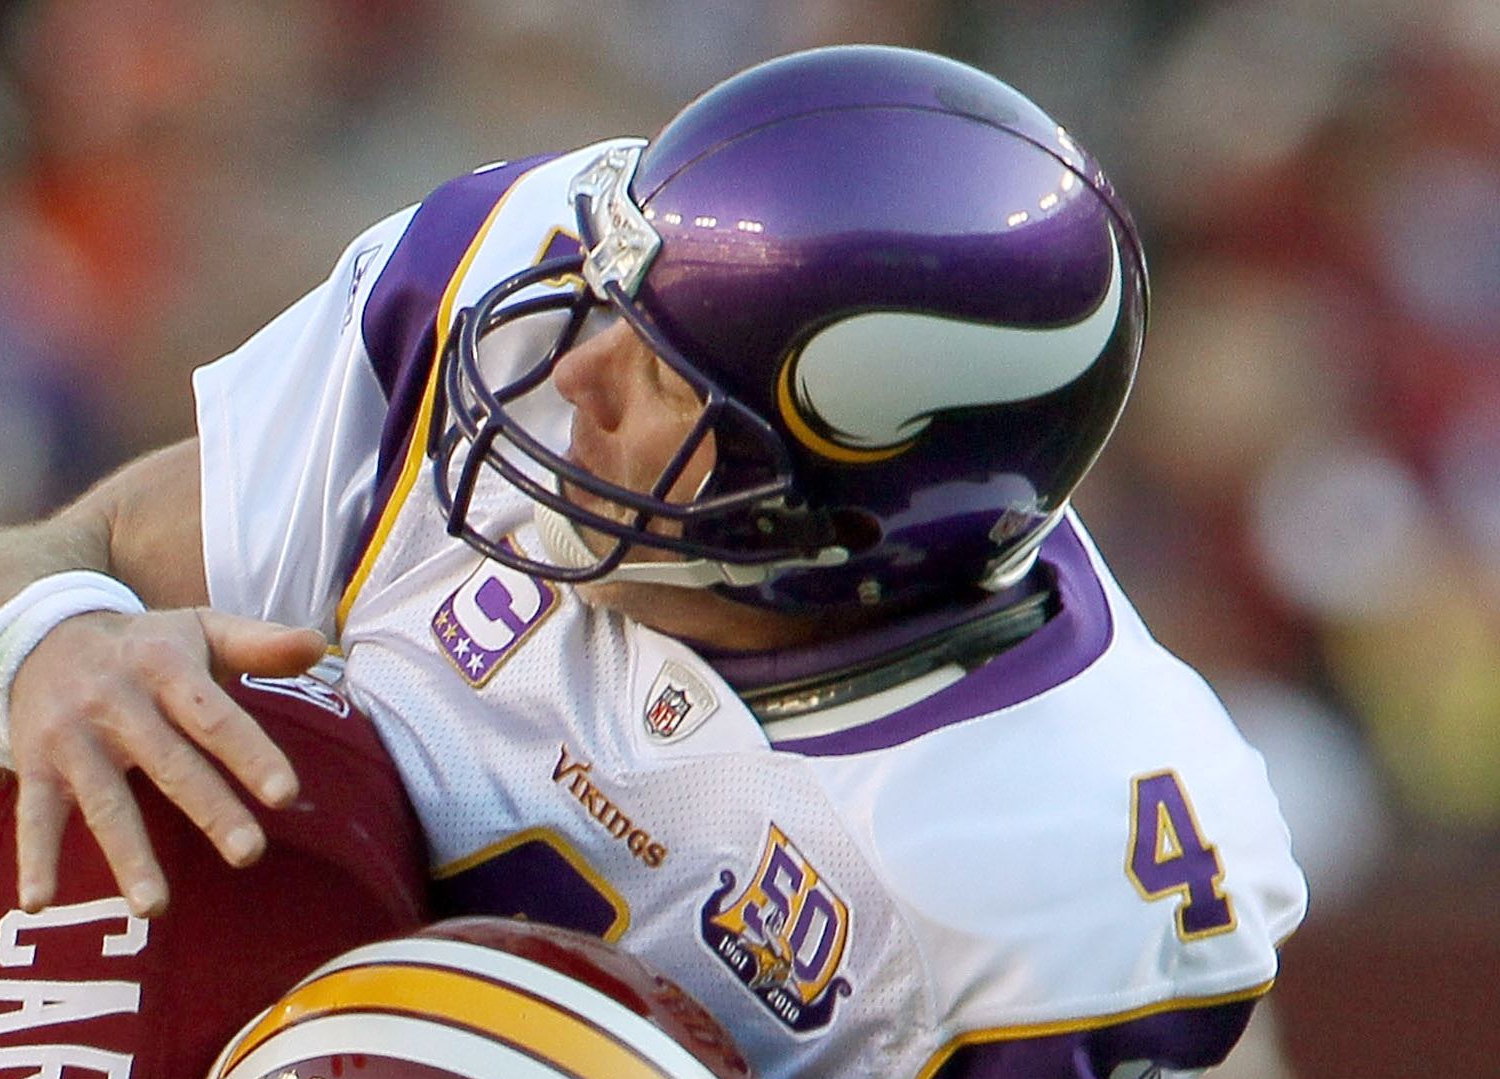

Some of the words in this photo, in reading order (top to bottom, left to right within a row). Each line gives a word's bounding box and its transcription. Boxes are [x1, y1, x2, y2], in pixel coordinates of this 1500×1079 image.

[452, 553, 542, 652] C
[650, 700, 679, 733] NFL
[1125, 768, 1238, 942] 4
[742, 843, 841, 982] 50
[718, 935, 749, 971] 1961
[766, 987, 800, 1023] 2010
